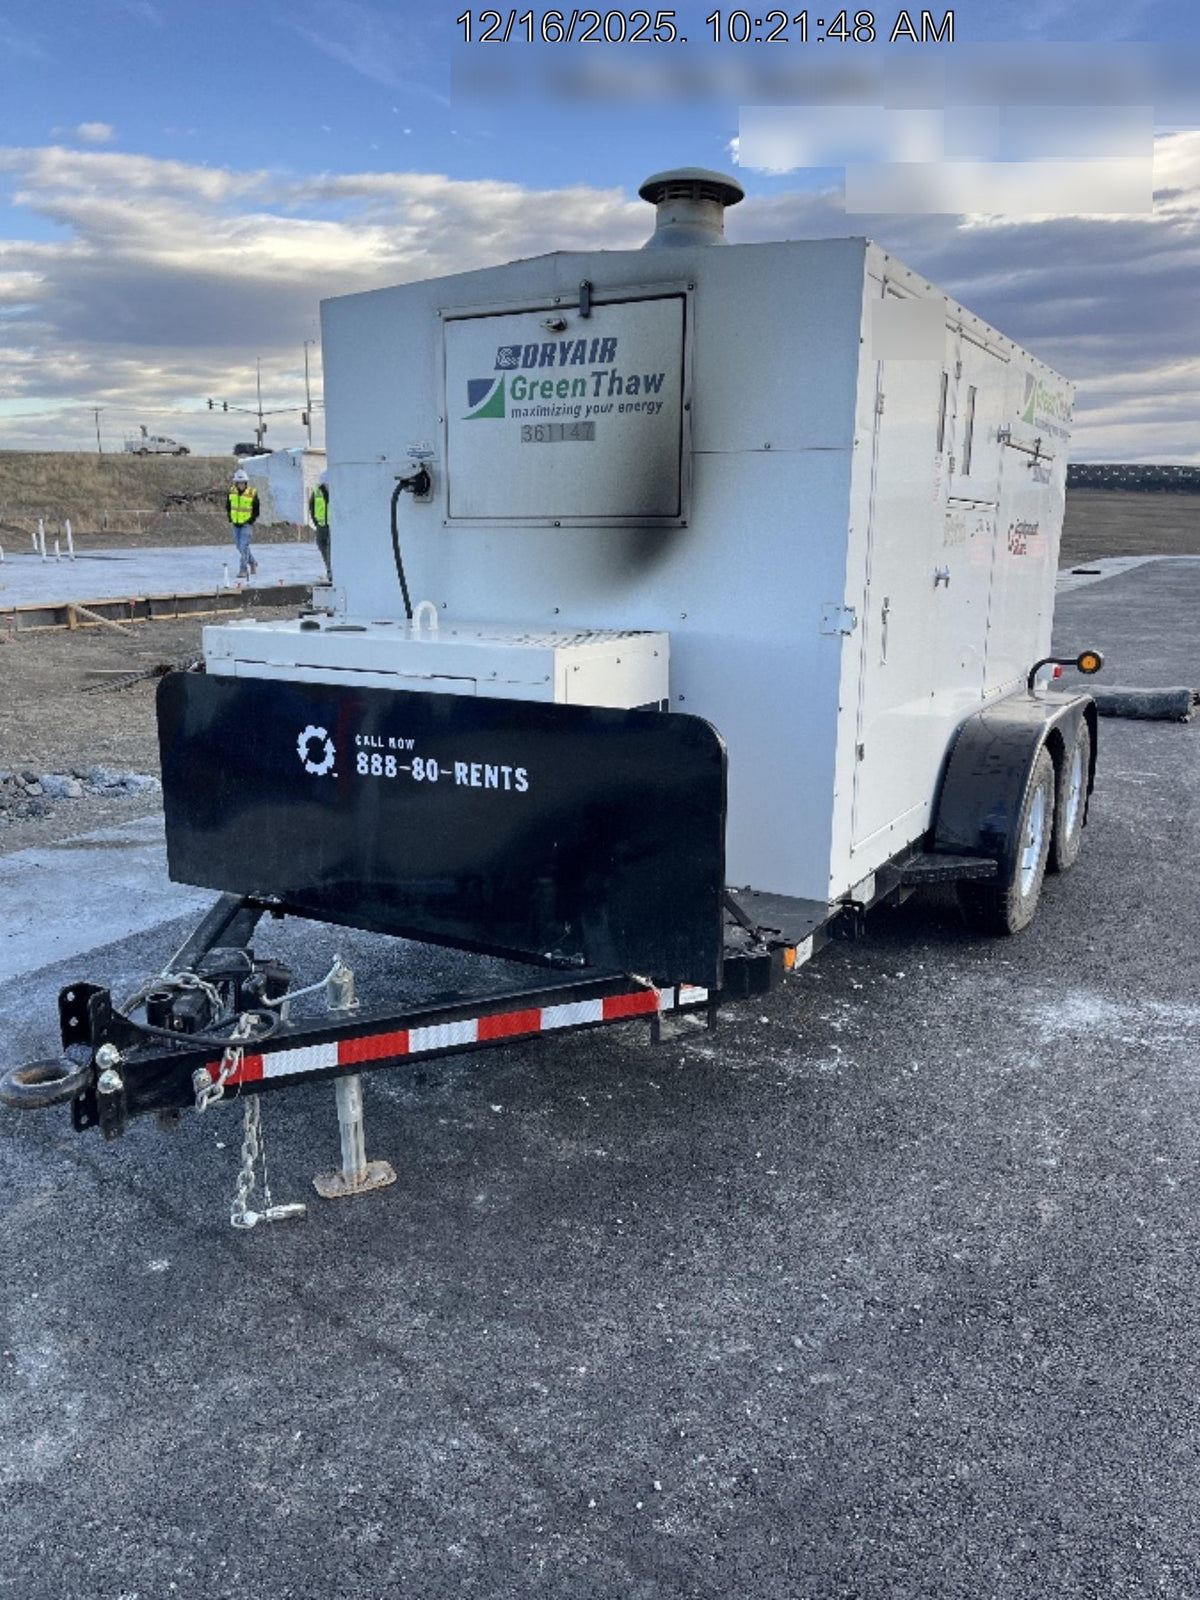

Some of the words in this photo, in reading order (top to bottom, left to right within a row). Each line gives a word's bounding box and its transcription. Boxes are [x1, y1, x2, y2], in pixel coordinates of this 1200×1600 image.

[520, 337, 618, 368] DRYAIR
[511, 403, 582, 419] maximizing
[584, 405, 614, 418] your
[618, 400, 664, 415] energy
[355, 733, 385, 747] CALL
[388, 736, 415, 751] NOW
[356, 751, 529, 792] 888-80-RENTS
